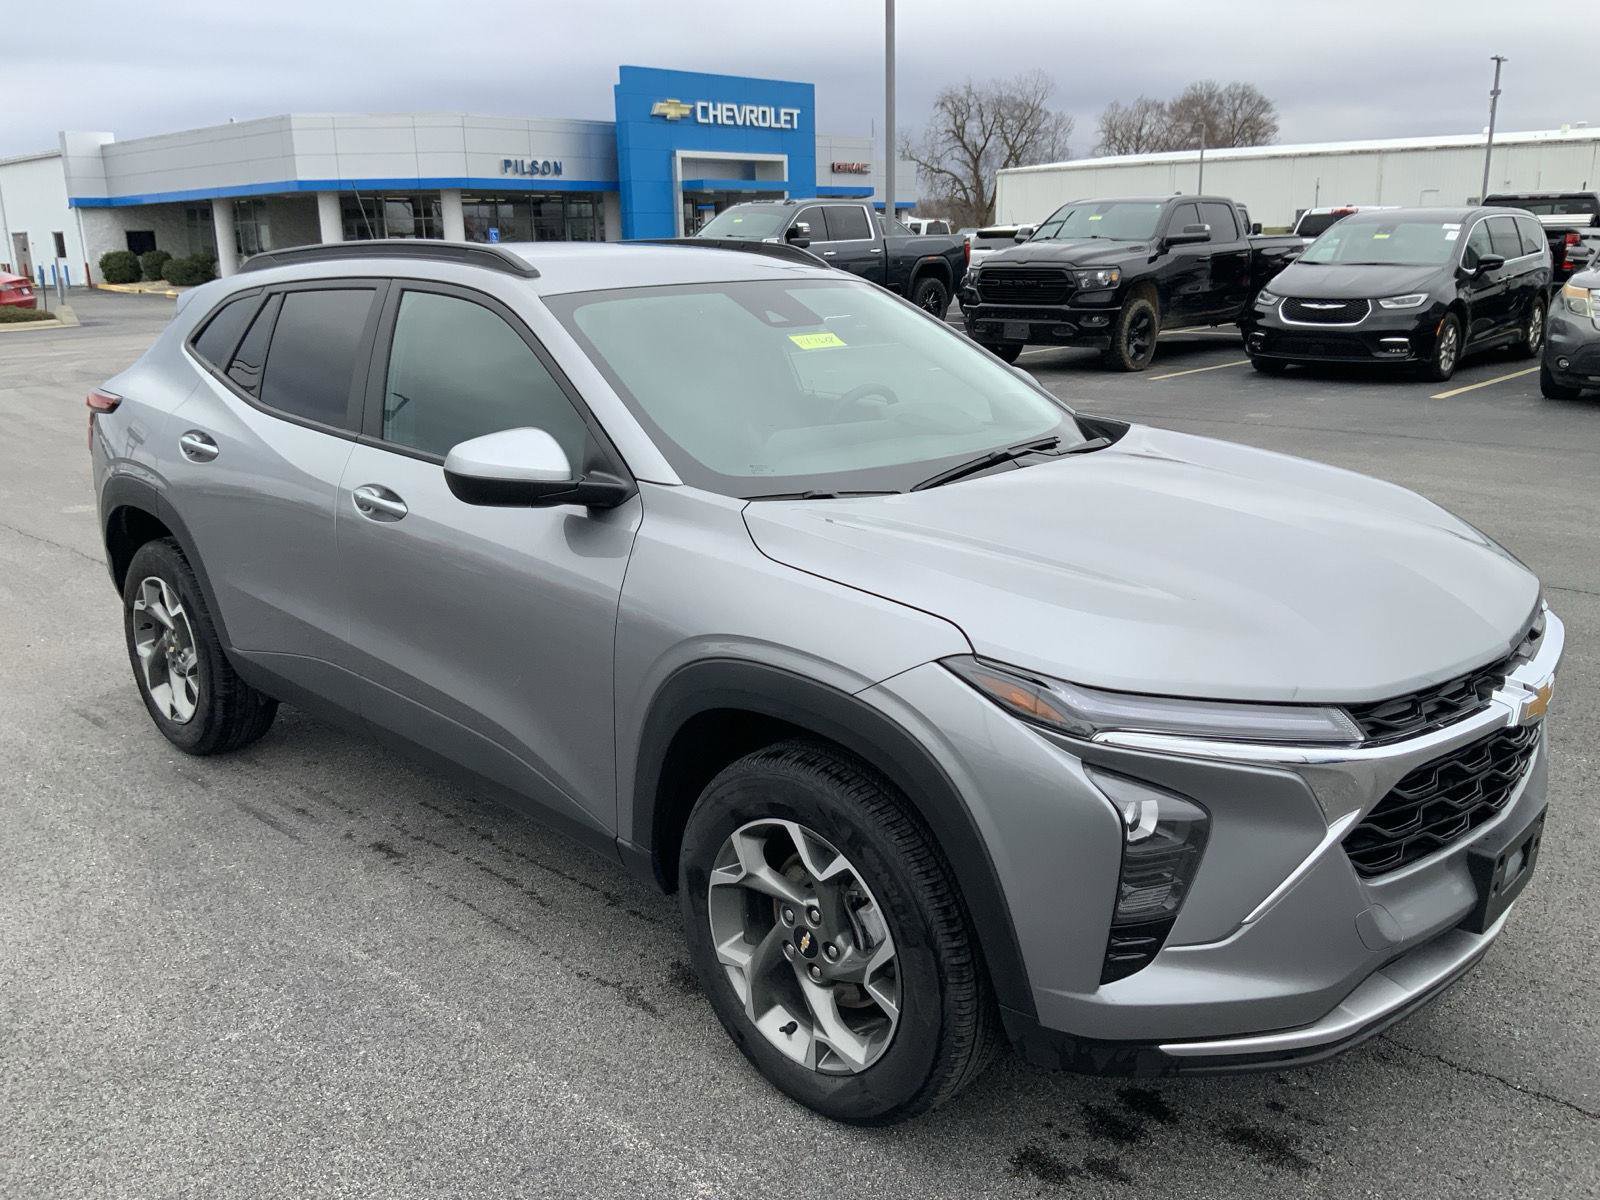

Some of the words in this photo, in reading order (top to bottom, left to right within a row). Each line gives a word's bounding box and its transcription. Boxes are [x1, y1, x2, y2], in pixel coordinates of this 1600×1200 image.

[696, 101, 801, 129] CHEVROLET
[502, 159, 562, 176] PILSON
[832, 161, 871, 174] GMC
